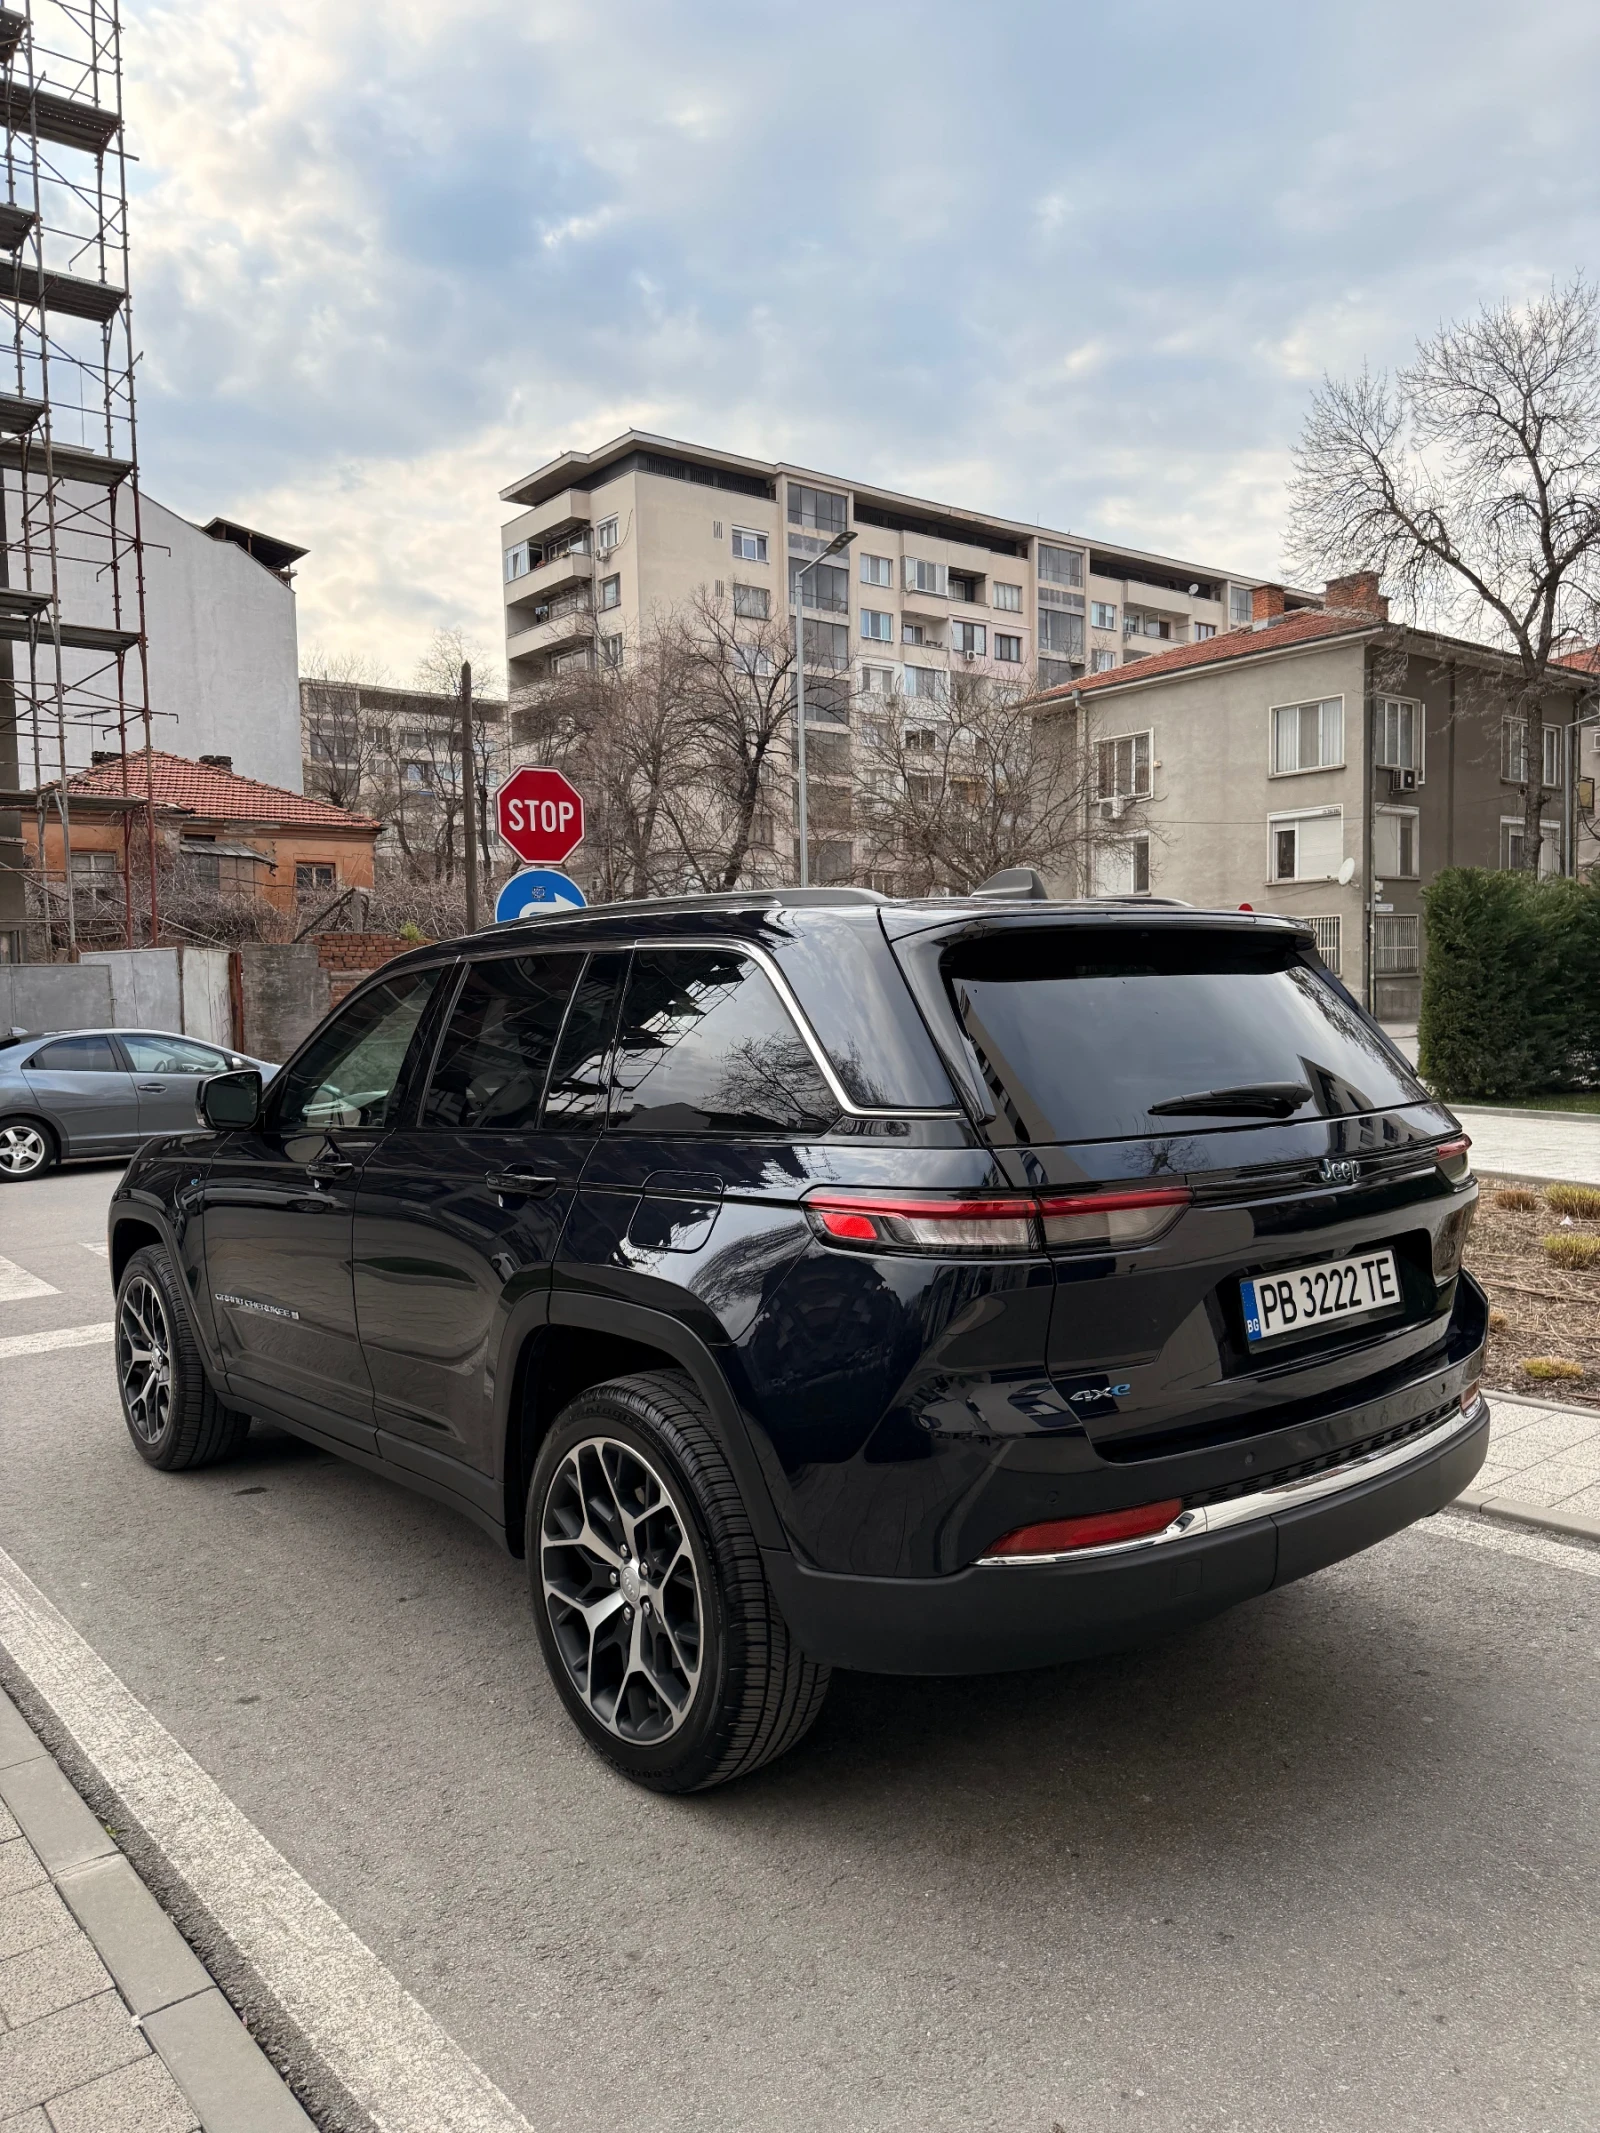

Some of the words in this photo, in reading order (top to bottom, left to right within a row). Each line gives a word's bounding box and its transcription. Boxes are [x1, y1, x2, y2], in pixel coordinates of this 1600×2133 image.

[508, 798, 574, 833] STOP
[1319, 1158, 1361, 1183] Jeep
[214, 1293, 243, 1306] GRAND
[245, 1300, 291, 1318] CHEROKEE
[1259, 1280, 1297, 1329] PB
[1300, 1266, 1362, 1318] 3222
[1360, 1257, 1396, 1302] TE
[1246, 1318, 1259, 1334] BG
